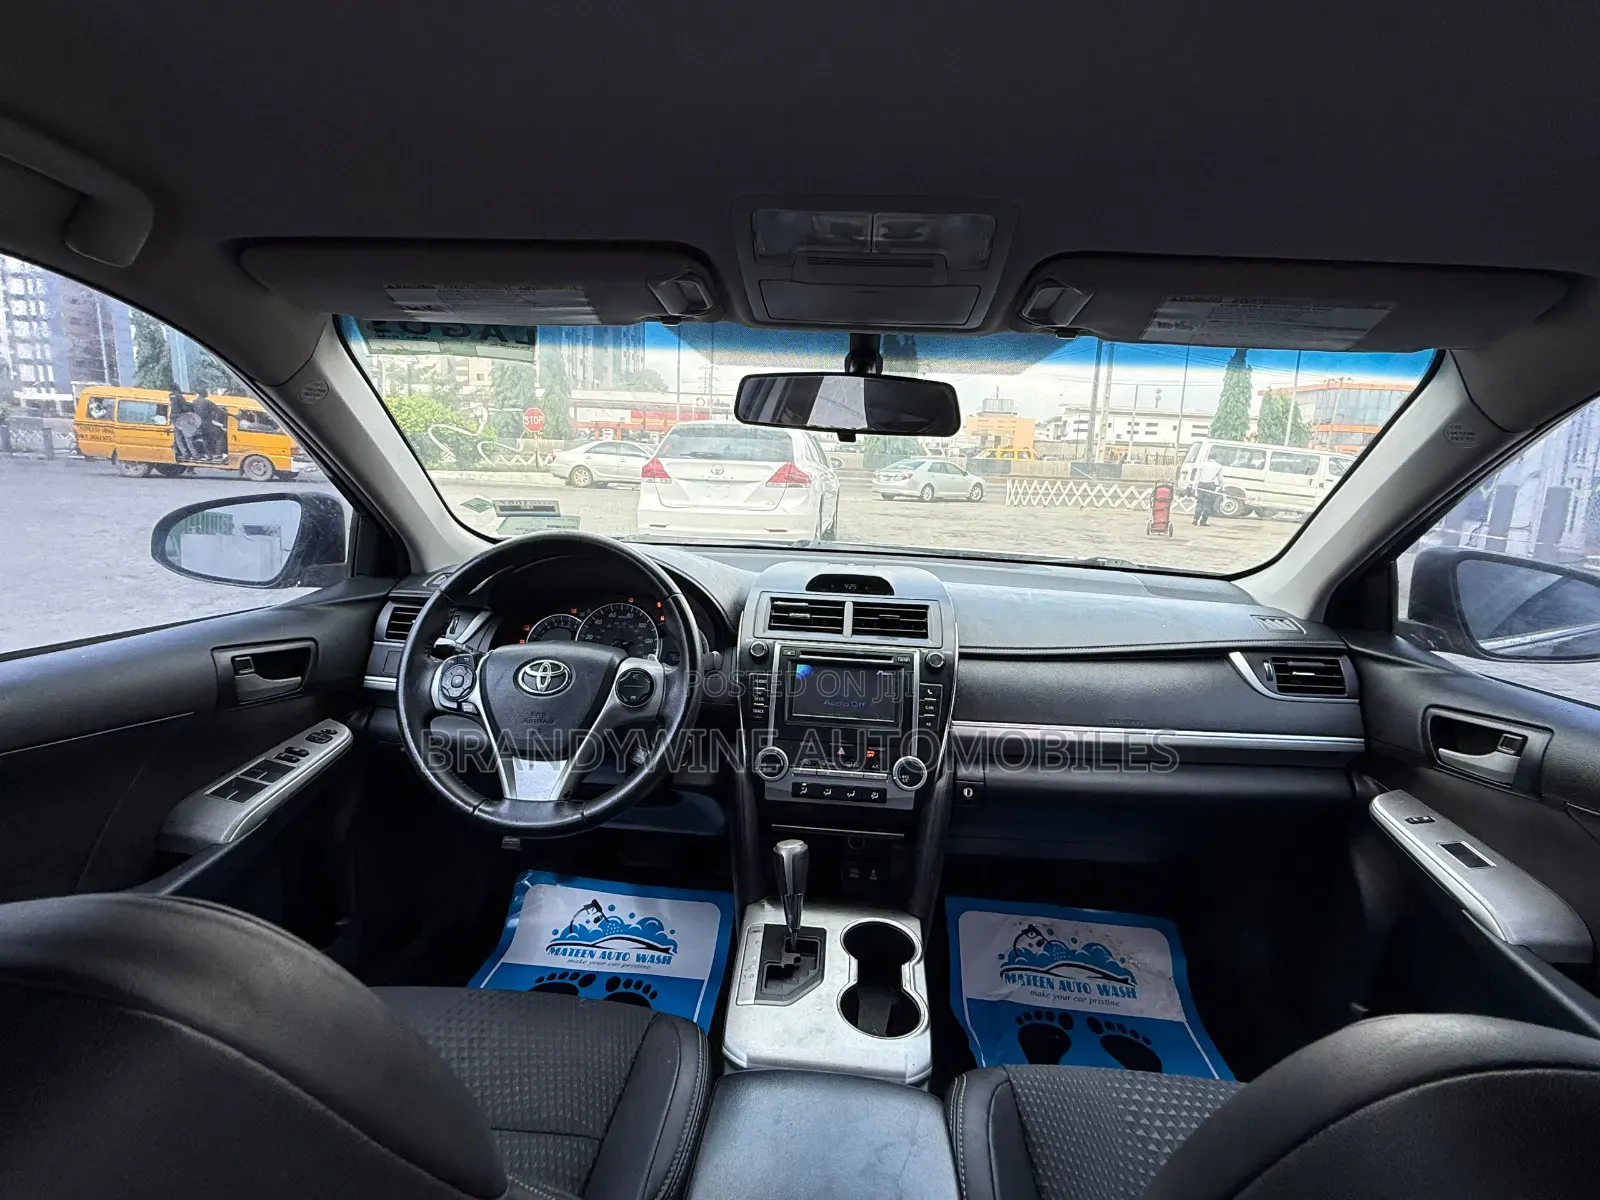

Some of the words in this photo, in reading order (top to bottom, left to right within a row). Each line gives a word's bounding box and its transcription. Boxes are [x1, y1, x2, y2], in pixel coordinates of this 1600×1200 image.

[524, 415, 544, 425] STOP
[822, 699, 850, 707] Audo
[548, 947, 596, 958] MATEEN
[599, 951, 631, 961] AUTO
[635, 953, 673, 965] WASH
[620, 962, 652, 970] pristine
[1004, 973, 1055, 989] MATEEN
[1059, 980, 1092, 994] AUTO
[1096, 984, 1137, 998] WASH
[1030, 990, 1051, 998] make
[1052, 993, 1071, 1003] your
[1089, 998, 1120, 1006] pristine
